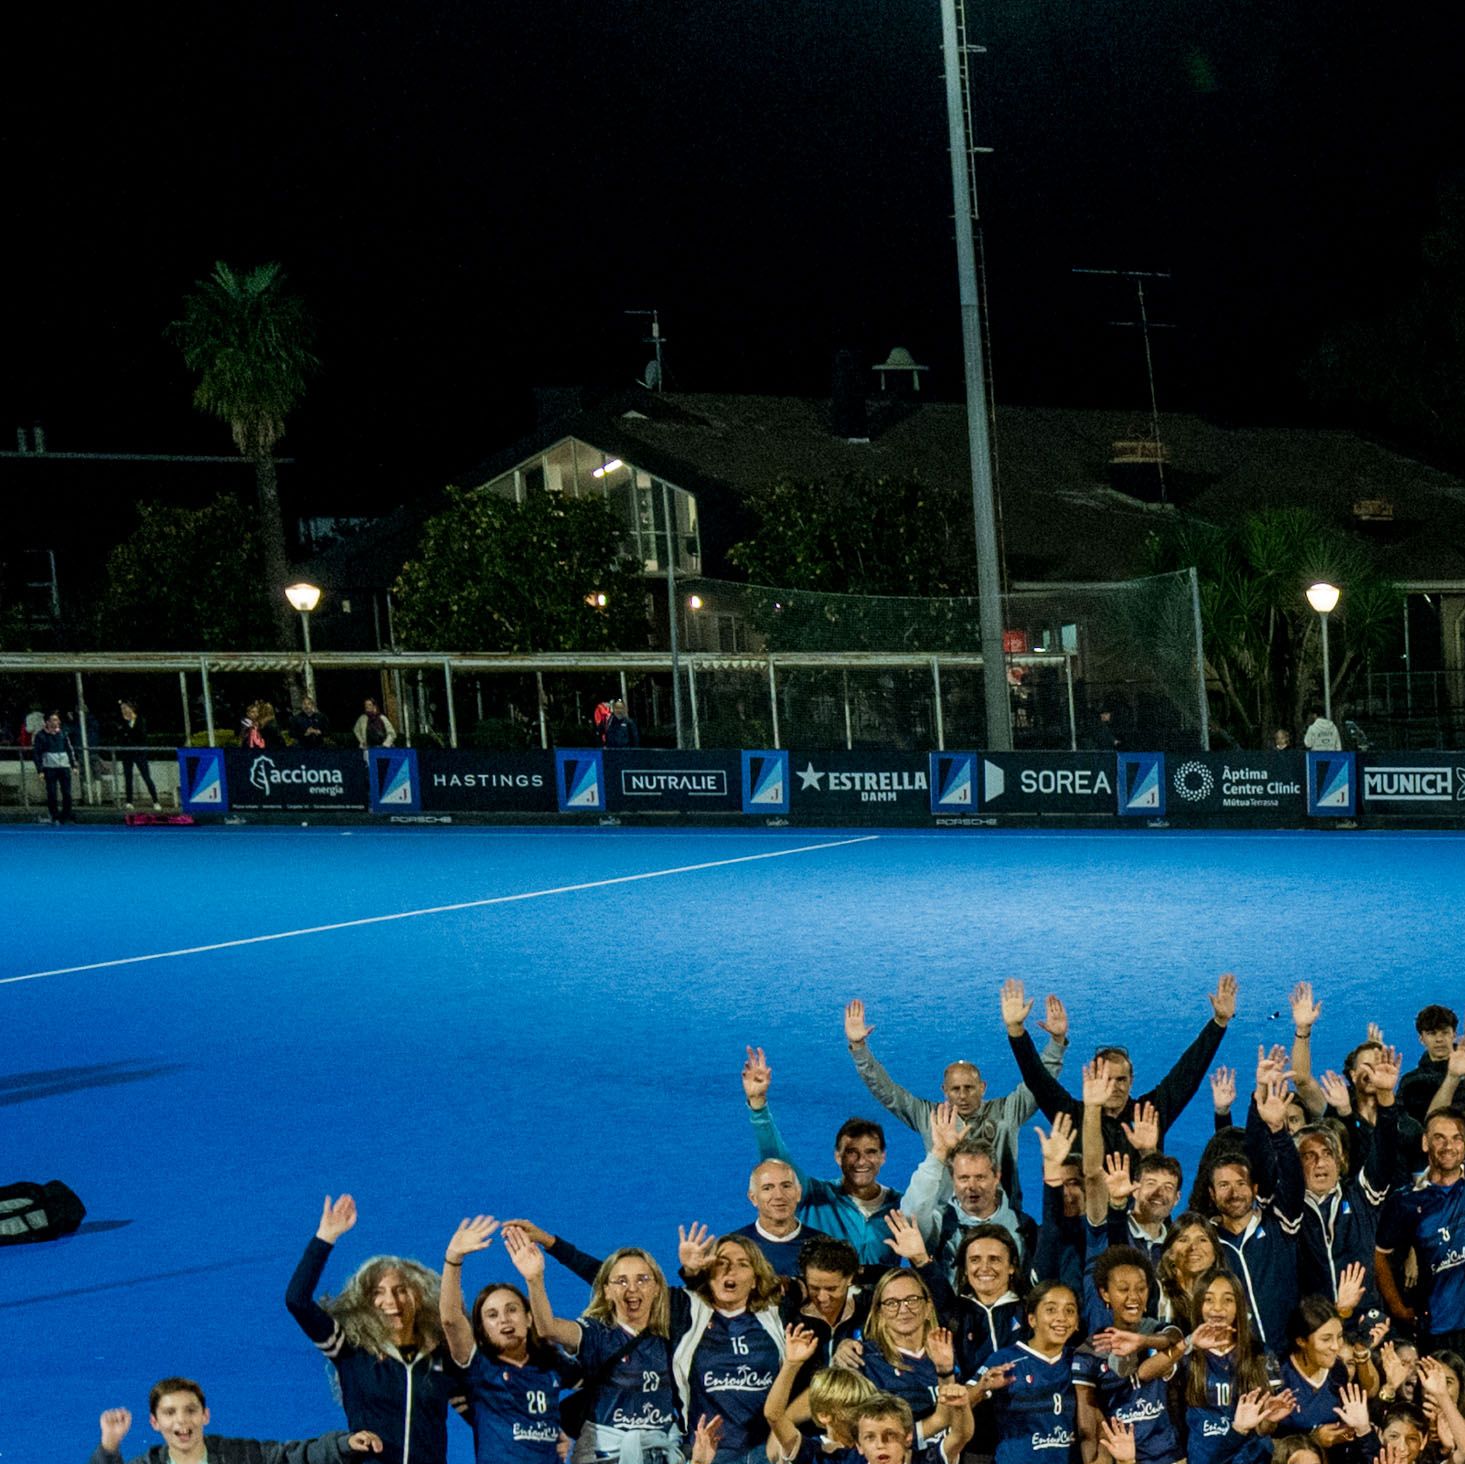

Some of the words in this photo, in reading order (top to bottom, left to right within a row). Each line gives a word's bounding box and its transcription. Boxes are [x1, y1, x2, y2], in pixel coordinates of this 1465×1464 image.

[270, 764, 343, 783] acciona
[434, 774, 544, 787] HASTINGS
[631, 776, 717, 790] NUTRALIE
[828, 771, 928, 791] ESTRELLA
[1020, 771, 1112, 794] SOREA
[1222, 766, 1268, 781] Àptima
[1222, 782, 1265, 795] Centre
[1266, 781, 1301, 795] Clínic
[1365, 773, 1453, 795] MUNICH
[861, 791, 897, 802] DAMM
[731, 1336, 749, 1355] 15
[643, 1371, 660, 1392] 23
[526, 1390, 547, 1413] 28
[1216, 1382, 1230, 1406] 10
[1053, 1393, 1062, 1415] 8
